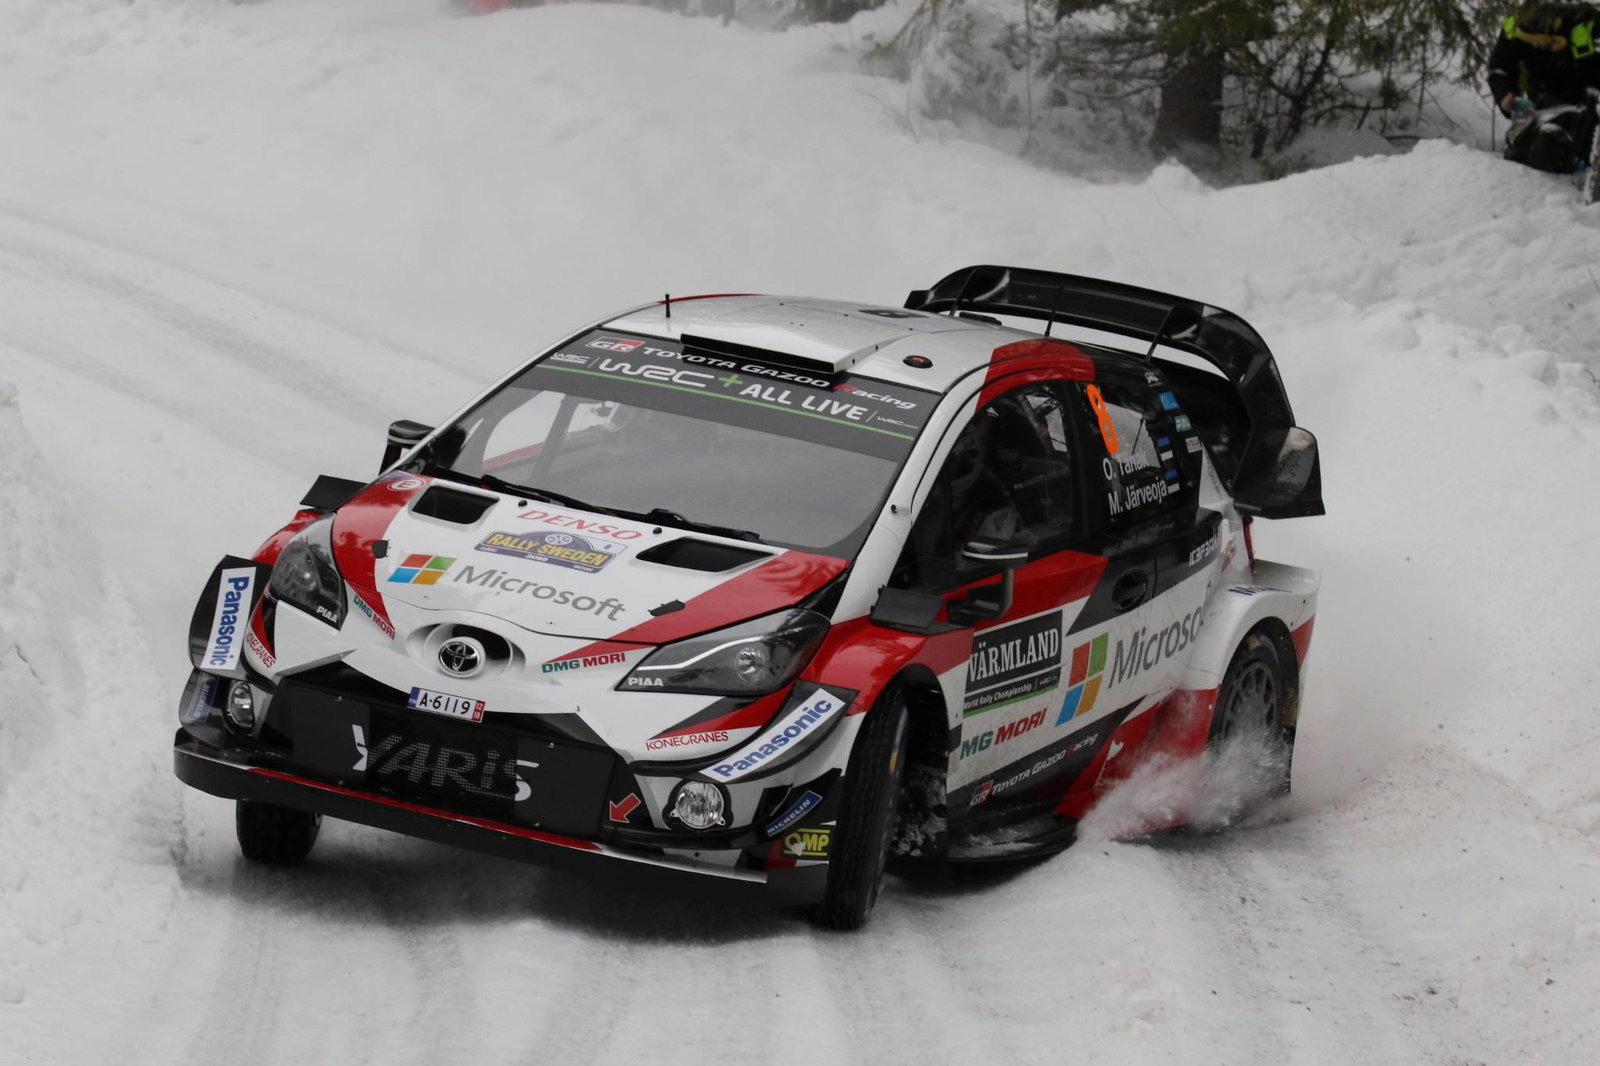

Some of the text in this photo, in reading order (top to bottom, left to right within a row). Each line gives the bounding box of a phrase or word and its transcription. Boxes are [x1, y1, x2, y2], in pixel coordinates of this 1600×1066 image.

[589, 340, 918, 410] GR TOYOTA GAZOO Racing
[738, 382, 795, 406] ALL
[801, 395, 869, 421] LIVE
[1086, 384, 1118, 455] 8
[1102, 457, 1118, 481] O.
[1108, 476, 1168, 516] M. Järveoja
[517, 510, 643, 541] DENSO
[487, 533, 610, 567] RALLY SWEDEN
[453, 565, 626, 622] Microsoft
[210, 576, 250, 666] Panasonic
[316, 604, 338, 624] PIAA
[353, 595, 396, 640] DMG MORI
[542, 651, 626, 673] DMG MORI
[967, 628, 1059, 682] VÄRMLAND
[628, 677, 664, 687] PIAA
[645, 731, 729, 751] KONECRANES
[713, 699, 832, 778] Panasonic
[994, 707, 1048, 746] MORI
[991, 770, 1030, 795] TOYOTA
[1032, 749, 1067, 775] GAZOO
[766, 799, 812, 836] MICHELIN
[784, 832, 830, 852] OMP
